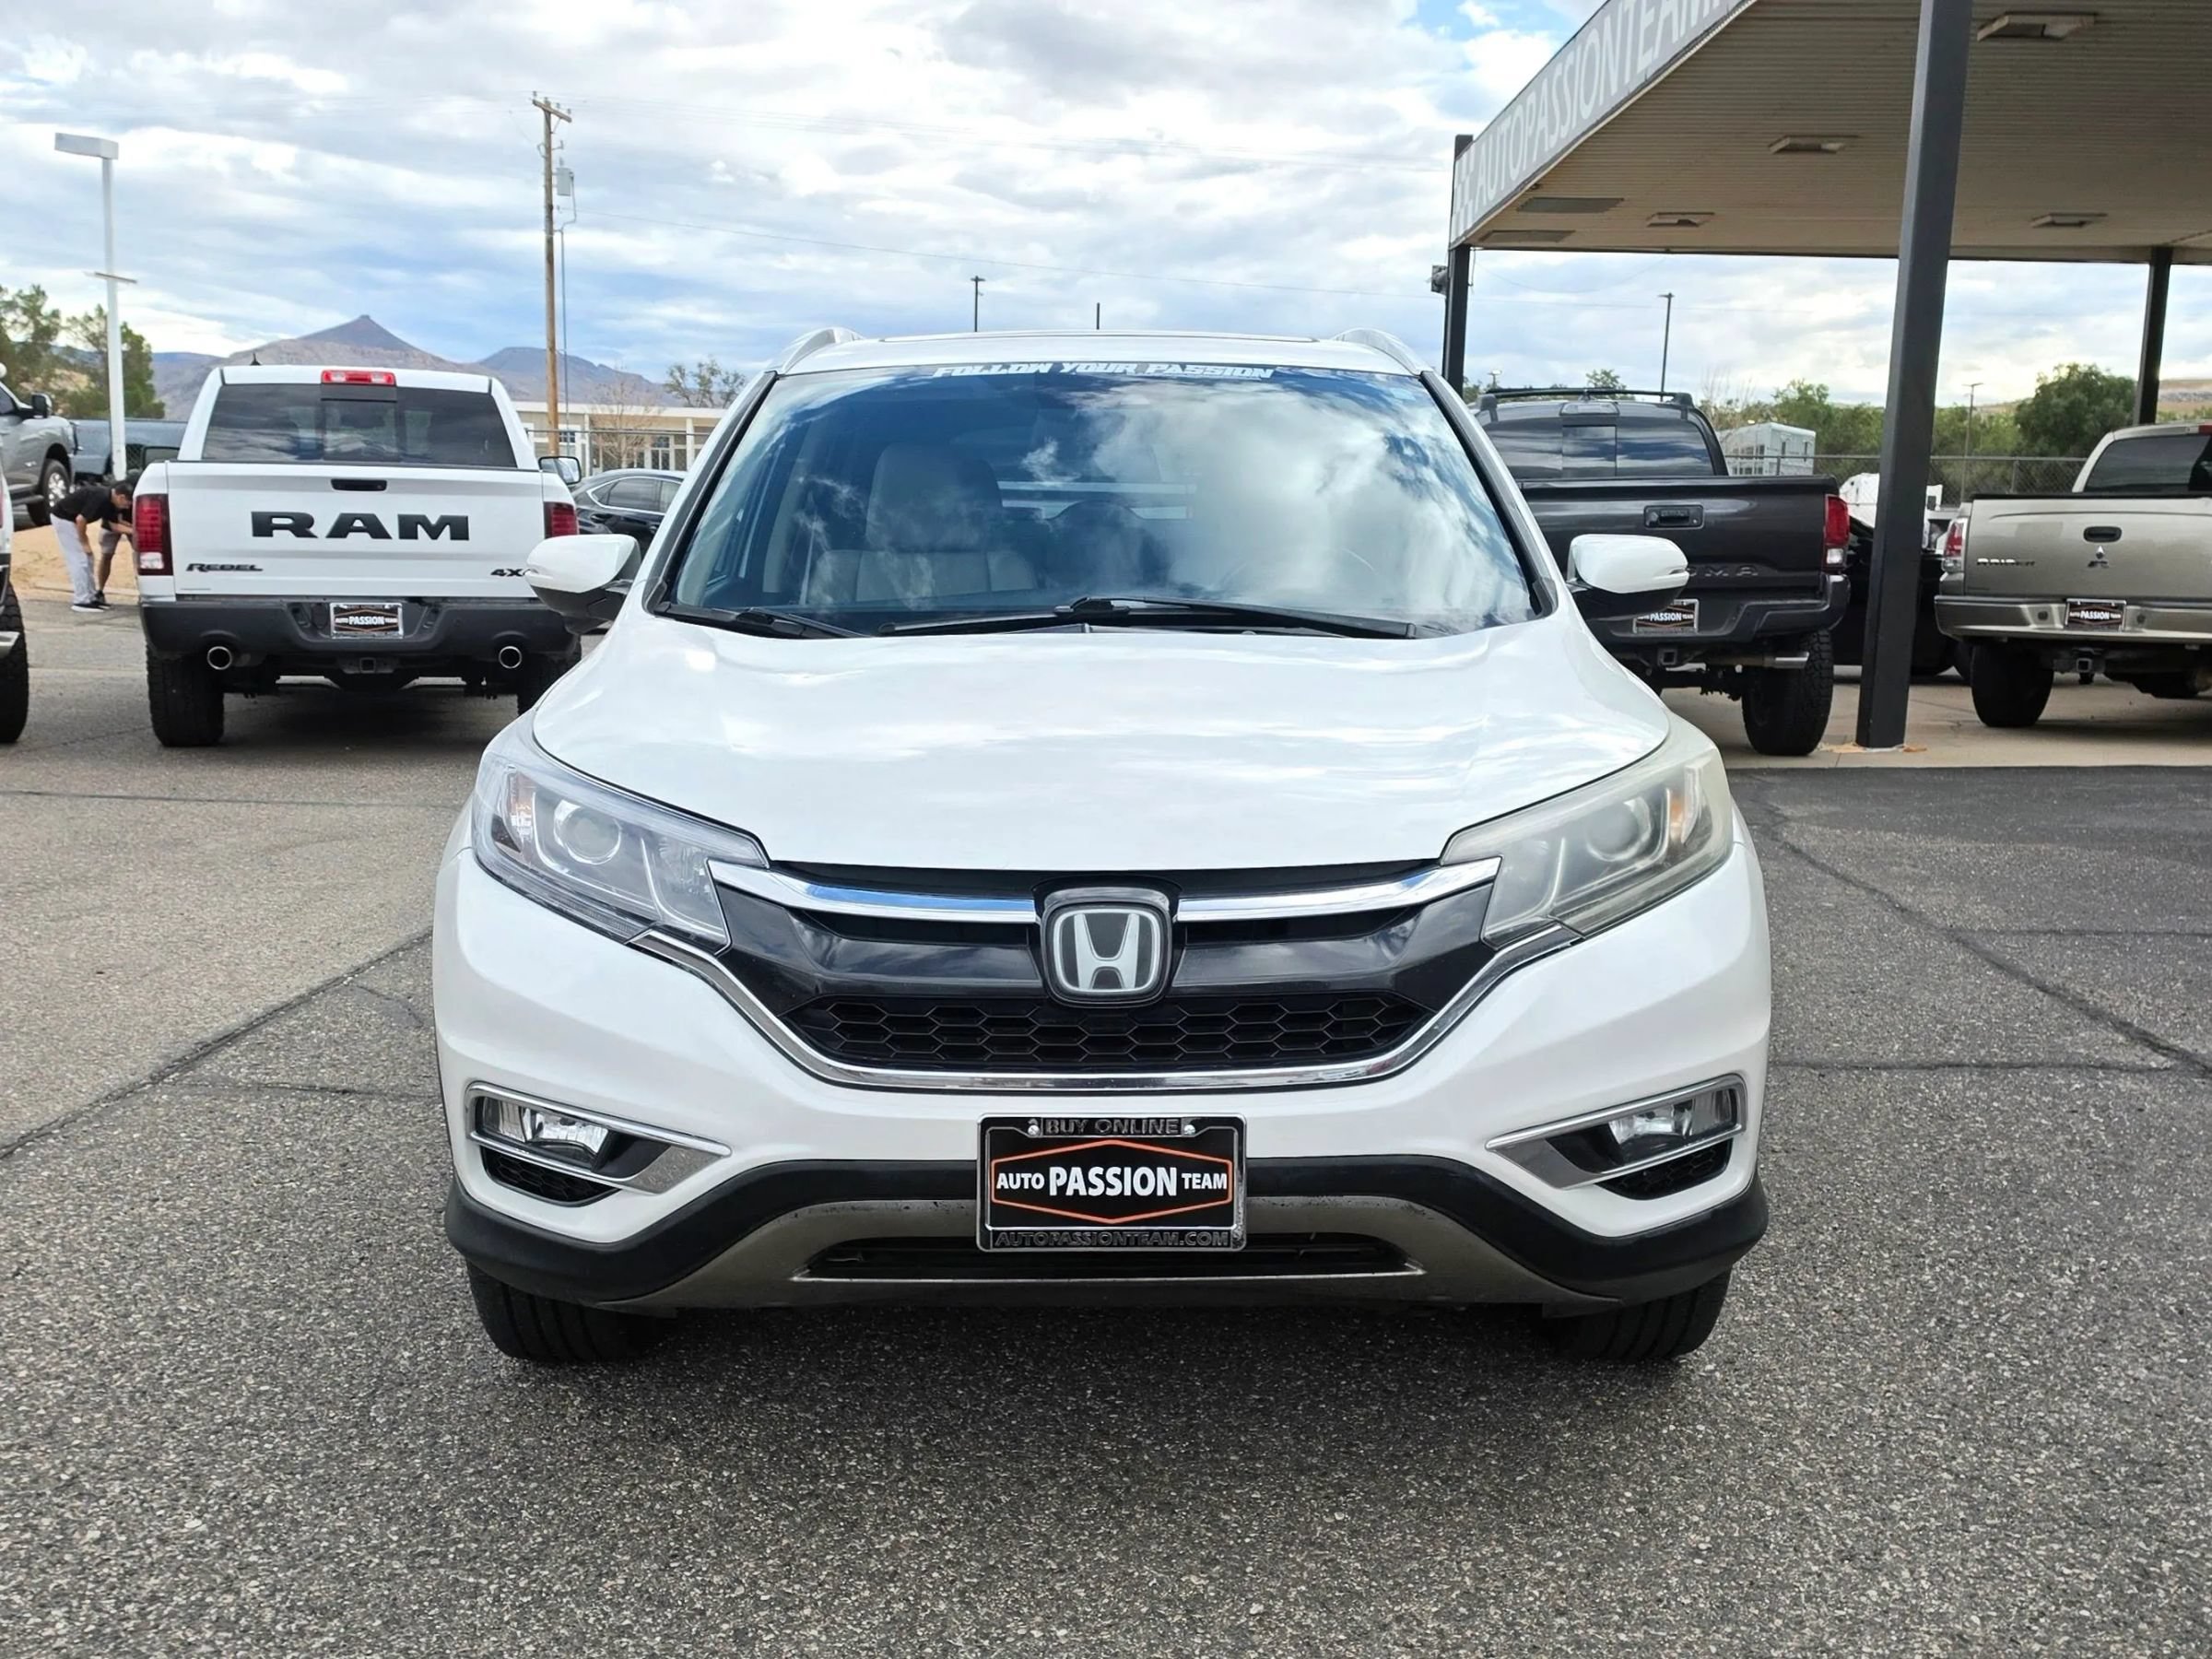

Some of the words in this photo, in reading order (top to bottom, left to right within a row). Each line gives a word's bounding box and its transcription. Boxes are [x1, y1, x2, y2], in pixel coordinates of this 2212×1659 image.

[1476, 0, 1712, 214] AUTOPASSIONTEA
[933, 363, 1053, 378] FOLLOW
[1060, 362, 1138, 375] YOUR
[1146, 363, 1275, 379] PASSION
[251, 511, 470, 541] RAM
[185, 563, 264, 572] REBEL
[348, 616, 384, 626] PASSION
[1650, 612, 1681, 622] PASSION
[2080, 610, 2110, 620] PASSION
[1045, 1118, 1087, 1135] BUY
[1095, 1118, 1180, 1135] ONLINE
[996, 1172, 1045, 1190] AUTO
[1049, 1166, 1177, 1196] PASSION
[1182, 1172, 1227, 1190] TEAM
[994, 1231, 1230, 1247] AUTOPASSIONTEAM.COM
